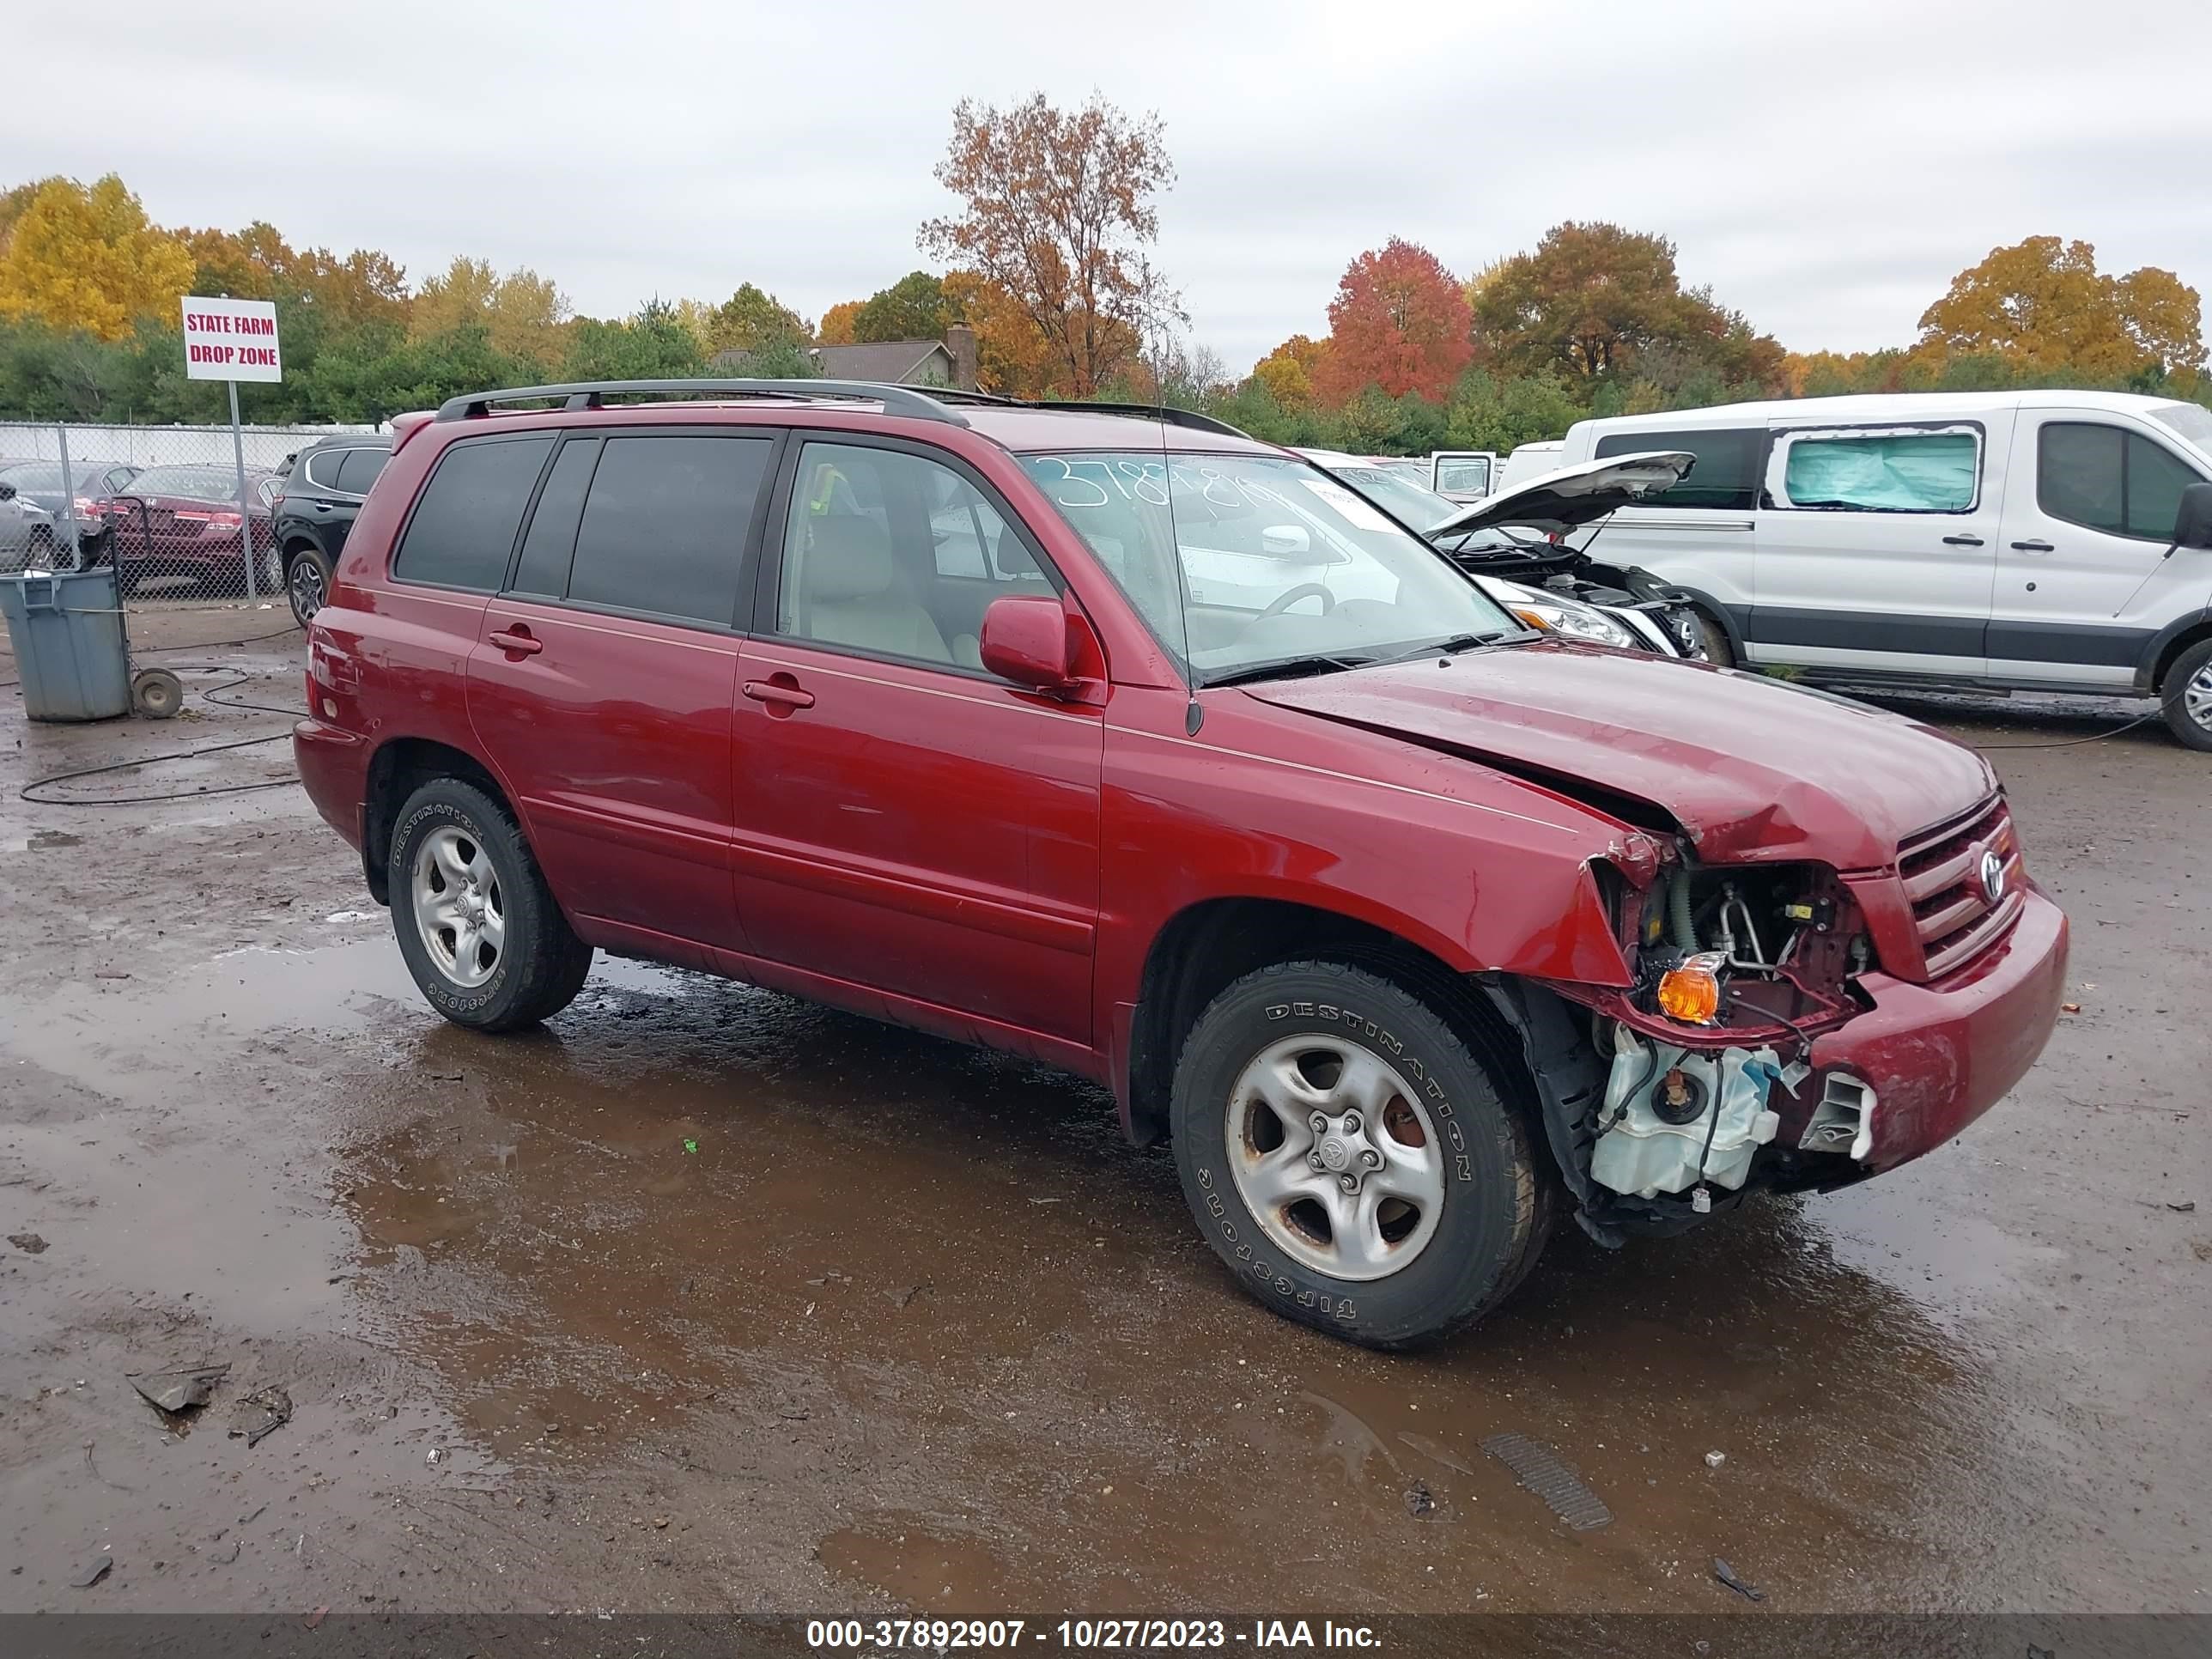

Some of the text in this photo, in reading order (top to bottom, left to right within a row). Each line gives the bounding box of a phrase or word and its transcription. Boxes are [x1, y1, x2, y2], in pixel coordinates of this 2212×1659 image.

[187, 313, 274, 336] STATE FARM
[190, 344, 277, 366] DROP ZONE
[393, 804, 483, 867] DESTINATION
[1265, 1001, 1473, 1182] DESTINATION
